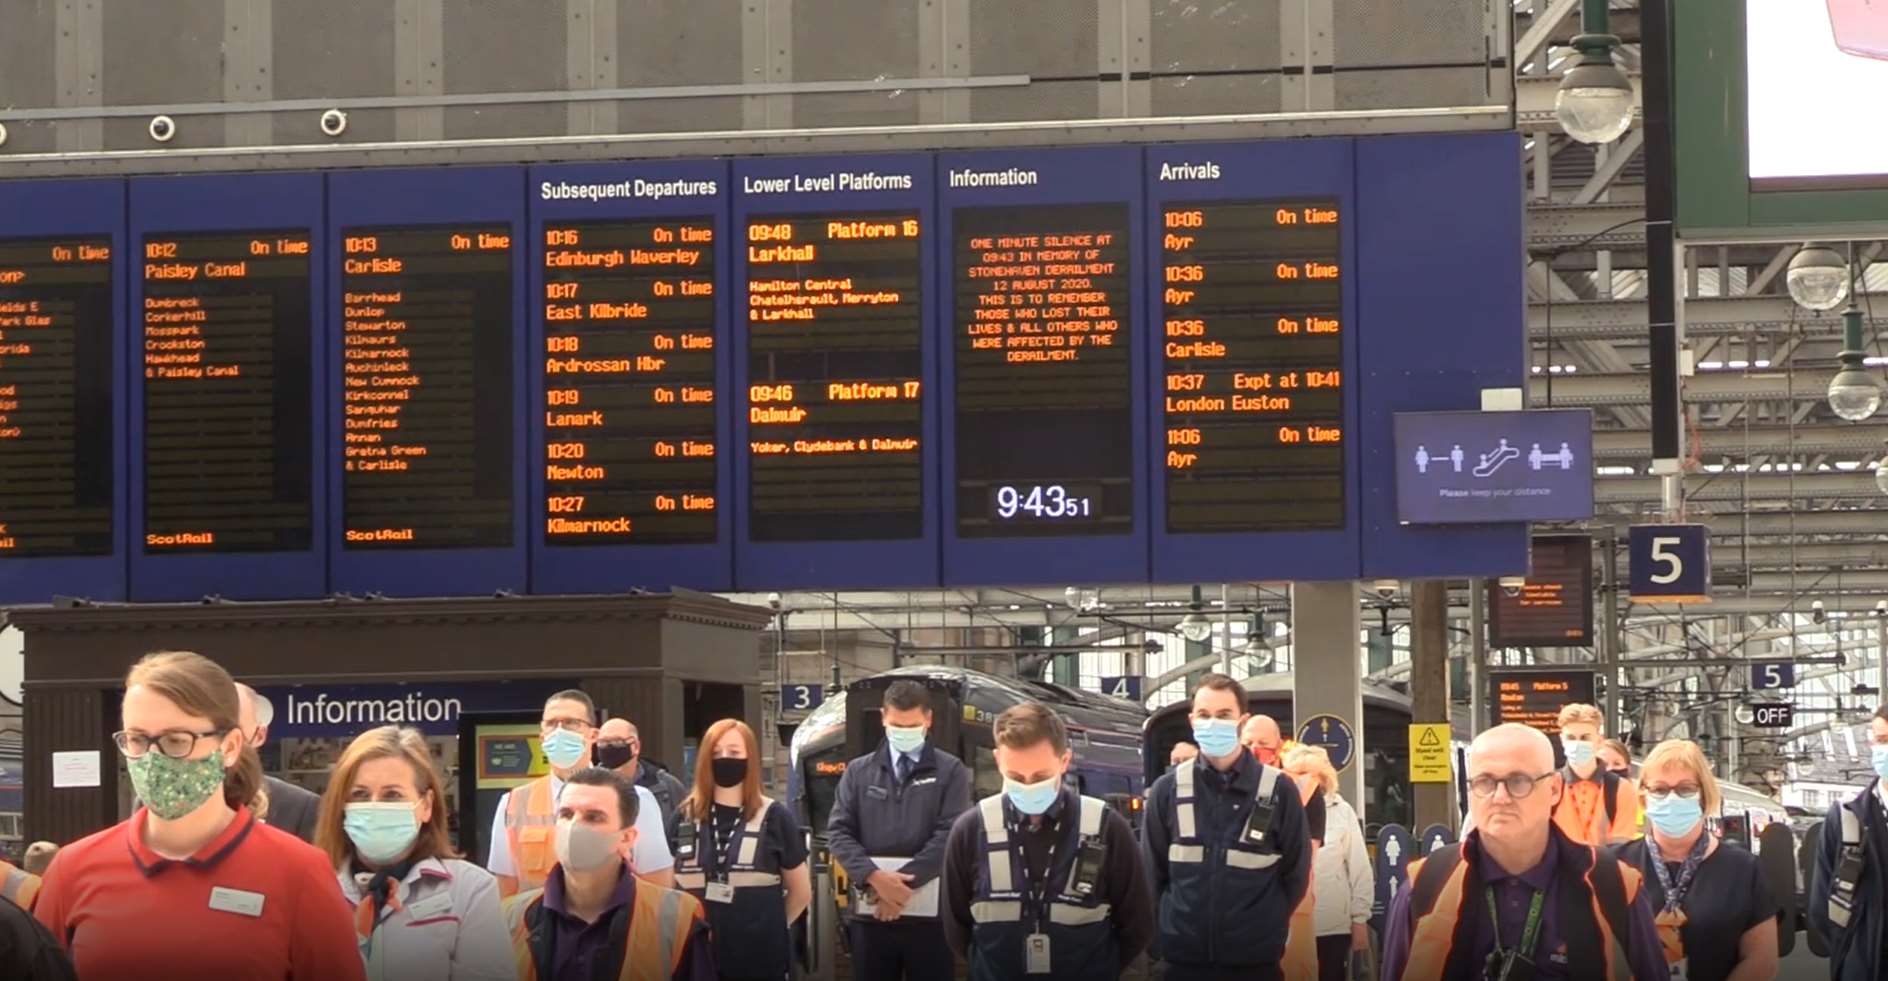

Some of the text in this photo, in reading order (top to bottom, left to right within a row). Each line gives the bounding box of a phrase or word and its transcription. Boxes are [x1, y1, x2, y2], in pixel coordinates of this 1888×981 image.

[950, 169, 1037, 186] Information
[1160, 162, 1220, 180] Arrivals
[542, 180, 716, 201] Subsequent Departures
[745, 172, 911, 193] Lower Level Platforms
[1165, 209, 1337, 227] 10:06 On time
[547, 228, 712, 245] 10:16 On time
[750, 220, 918, 240] 09:48 Platform 16
[147, 240, 308, 257] 10:12 On time
[346, 234, 509, 252] 10:13 On time
[971, 235, 1111, 248] ONE MINUTE SILENCE AT
[1165, 234, 1193, 250] Ayr
[53, 246, 108, 260] On time
[546, 249, 699, 267] Edinburgh Waverley
[750, 245, 815, 262] Larkhall
[983, 250, 1099, 262] 09:43 IN MEMORY OF
[146, 262, 245, 279] Paisley Canal
[346, 259, 401, 273] Carlisle
[970, 264, 1113, 277] STONEHAVEN DERAILMENT
[1166, 263, 1338, 281] 10:36 On time
[547, 281, 712, 298] 10:17 On time
[750, 279, 851, 292] Hamilton Central
[995, 279, 1094, 290] 12 AUGUST 2020.
[346, 293, 400, 303] Barrhead
[750, 292, 898, 306] Chatelherault, Merryton
[980, 293, 1105, 304] THIS IS TO REMEMBER
[1165, 288, 1194, 304] Ayr
[146, 311, 205, 322] Corkerhill
[346, 307, 384, 317] Dunlop
[547, 303, 647, 320] East Kilbride
[750, 308, 814, 320] & Larkhall
[975, 306, 1110, 319] THOSE WHO LOST THEIR
[347, 321, 405, 330] Stewarton
[969, 321, 1117, 334] LIVES & ALL OTHERS WHO
[1167, 318, 1338, 336] 10:36 On time
[147, 340, 204, 349] Crookston
[548, 334, 712, 352] 10:18 On time
[973, 335, 1111, 348] WERE AFFECTED BY THE
[1166, 342, 1225, 357] Carlisle
[1008, 350, 1079, 361] DERAILMENT.
[159, 366, 238, 377] Paisley Canal
[547, 356, 665, 372] Ardrossan Hbr
[372, 376, 418, 385] Cumnock
[1168, 372, 1339, 390] 10:37 Expt at 10:41
[346, 390, 408, 400] Kirkconnel
[548, 388, 712, 405] 10:19 On time
[750, 382, 919, 402] 09:46 Platform 17
[1167, 395, 1289, 412] London Euston
[547, 411, 602, 426] Lanark
[750, 407, 806, 423] Dalmuir
[1168, 427, 1340, 444] 11:06 On time
[391, 446, 426, 455] Green
[548, 442, 713, 458] 10:20 On time
[751, 439, 917, 453] Yoker, Clydebank & Dalmuir
[359, 460, 407, 470] Carlisle
[1168, 451, 1196, 468] Ayr
[548, 465, 603, 480] Newton
[549, 495, 714, 512] 10:27 On time
[998, 486, 1088, 517] 9:43 51
[548, 518, 630, 533] Kilmarnock
[147, 533, 212, 544] ScotRail
[347, 529, 412, 540] ScotRail
[1649, 537, 1682, 584] 5
[1764, 665, 1781, 688] 5
[1112, 679, 1130, 698] 4
[793, 686, 809, 709] 3
[288, 692, 461, 724] Information
[1757, 708, 1788, 724] OFF
